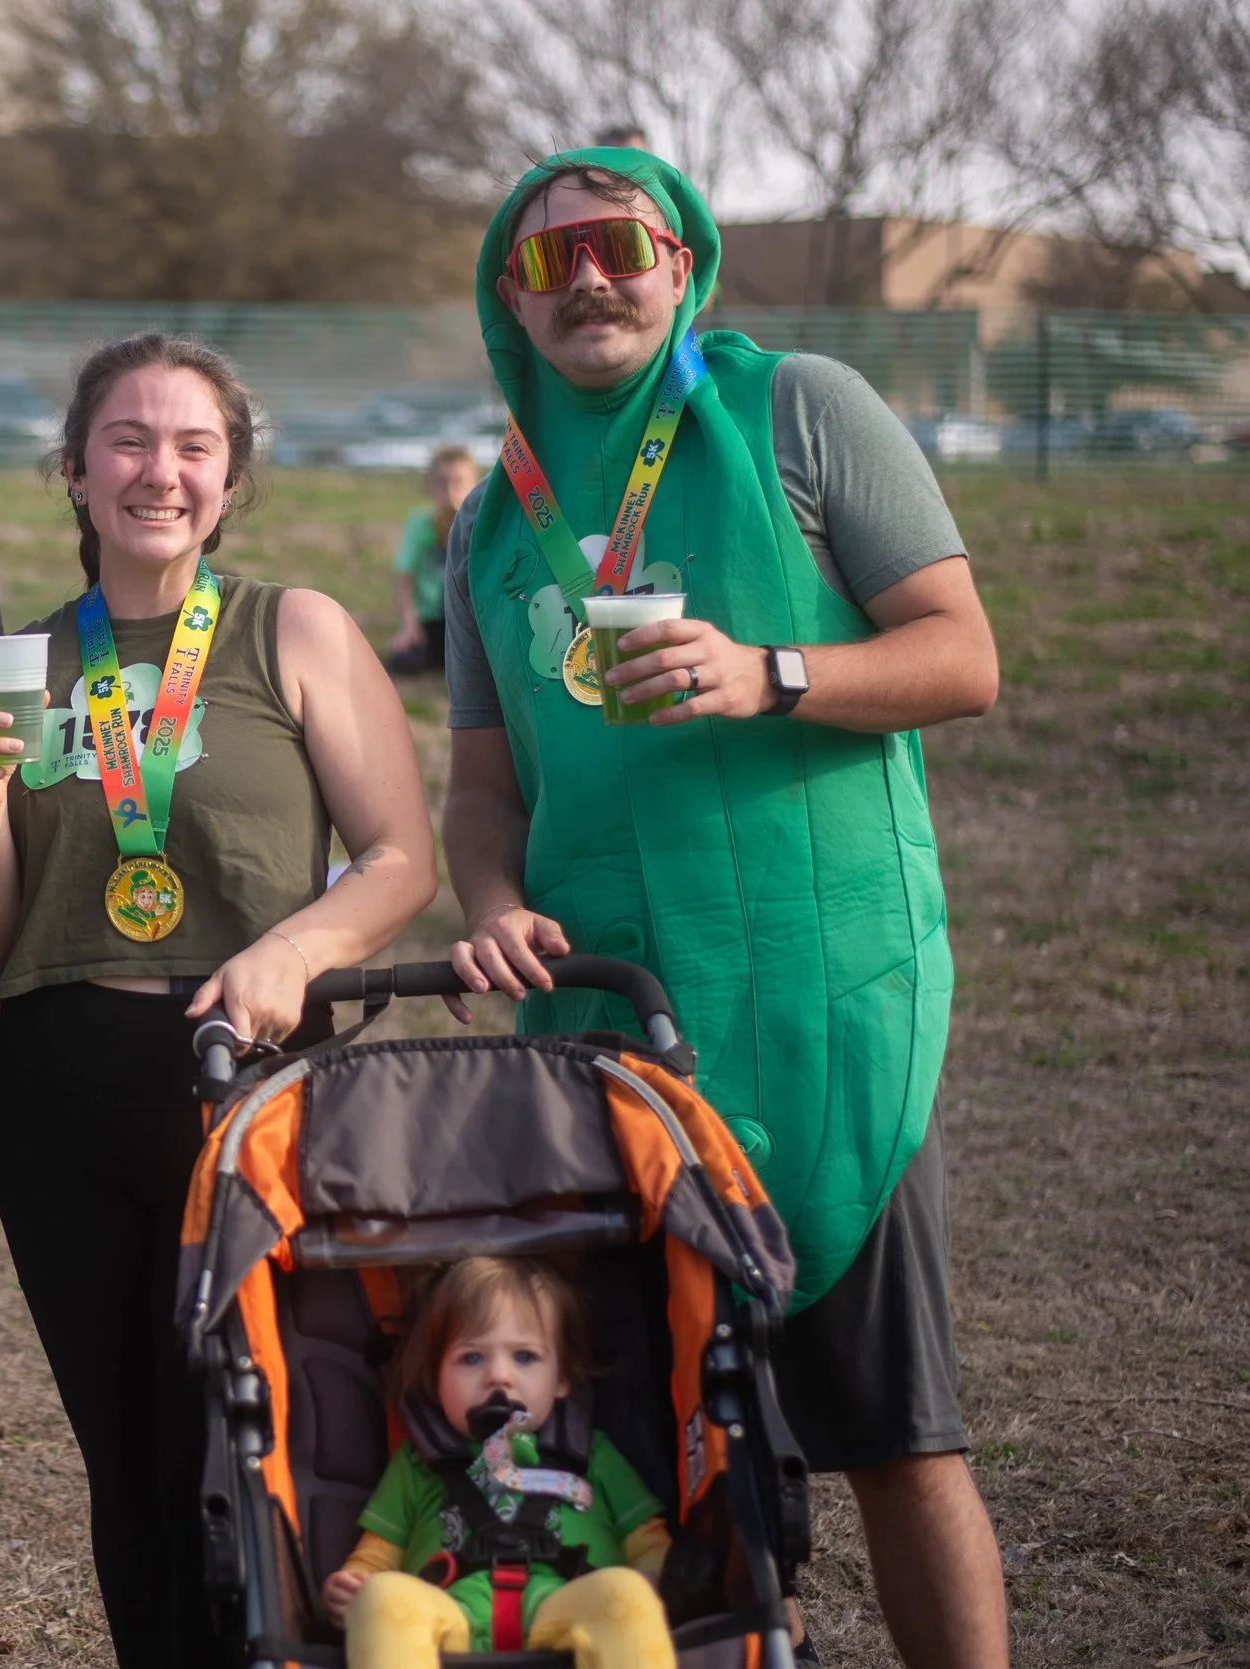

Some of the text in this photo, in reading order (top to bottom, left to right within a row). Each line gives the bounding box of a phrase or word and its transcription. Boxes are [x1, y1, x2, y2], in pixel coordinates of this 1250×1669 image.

[663, 354, 690, 398] TRINITY
[672, 367, 697, 400] FALLS
[504, 441, 520, 475] FALLS
[509, 433, 533, 474] TRINITY
[646, 444, 659, 459] 5K
[526, 486, 555, 530] 2025
[613, 511, 641, 577] SHAMROCK
[635, 482, 651, 507] RUN
[194, 571, 211, 592] RUN
[193, 611, 205, 627] 5K
[98, 681, 110, 694] 5K
[166, 661, 181, 695] FALLS
[177, 665, 196, 706] TRINITY
[111, 707, 135, 788] SHAMROCK RUN
[153, 716, 177, 757] 2025
[65, 752, 98, 763] TRINITY
[65, 760, 90, 769] FALLS
[159, 894, 173, 904] 5K
